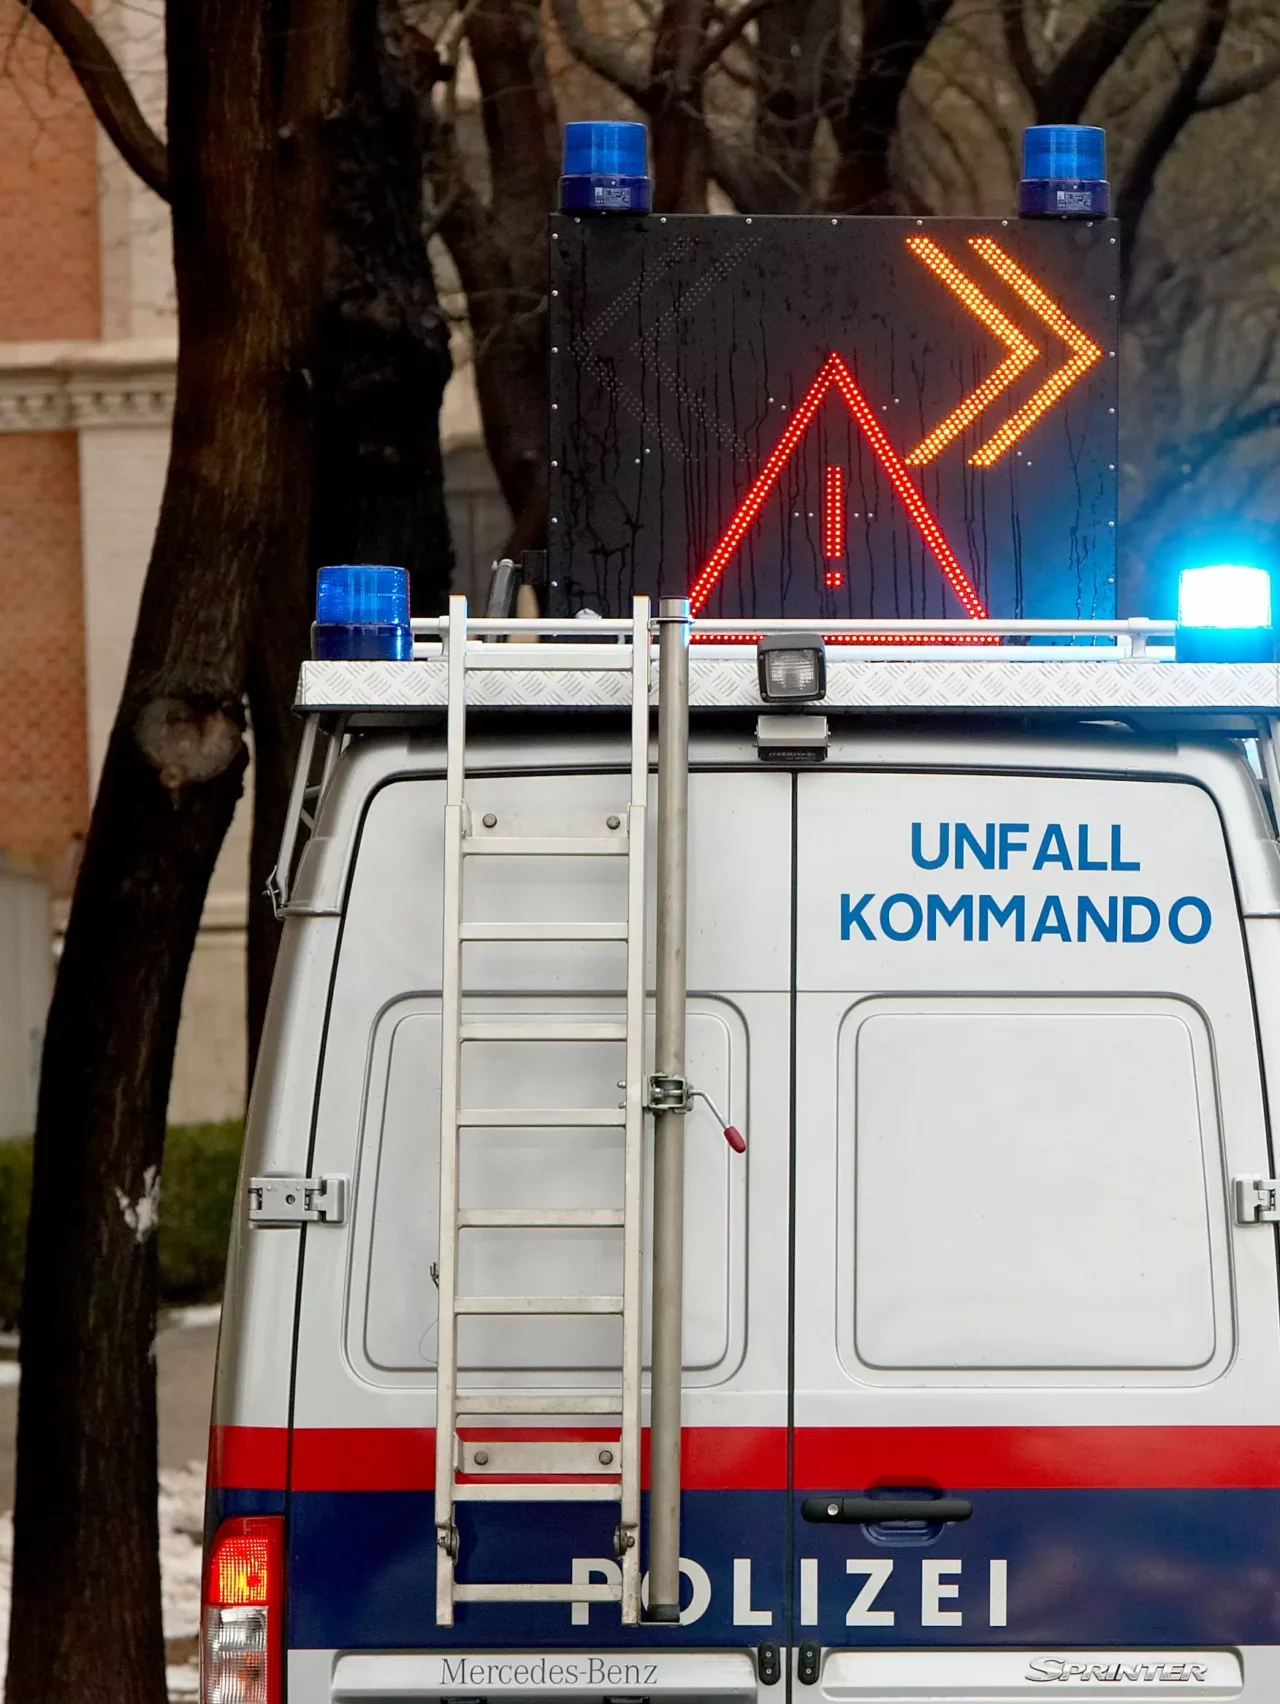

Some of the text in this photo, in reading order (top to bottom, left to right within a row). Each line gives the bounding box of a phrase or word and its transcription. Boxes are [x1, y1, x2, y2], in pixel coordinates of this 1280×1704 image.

[911, 822, 1140, 871] UNFALL
[840, 893, 1212, 944] KOMMANDO
[571, 1557, 1008, 1627] POLIZEI
[439, 1657, 658, 1685] Mercedes-Benz
[1025, 1656, 1208, 1683] SPRINTER
